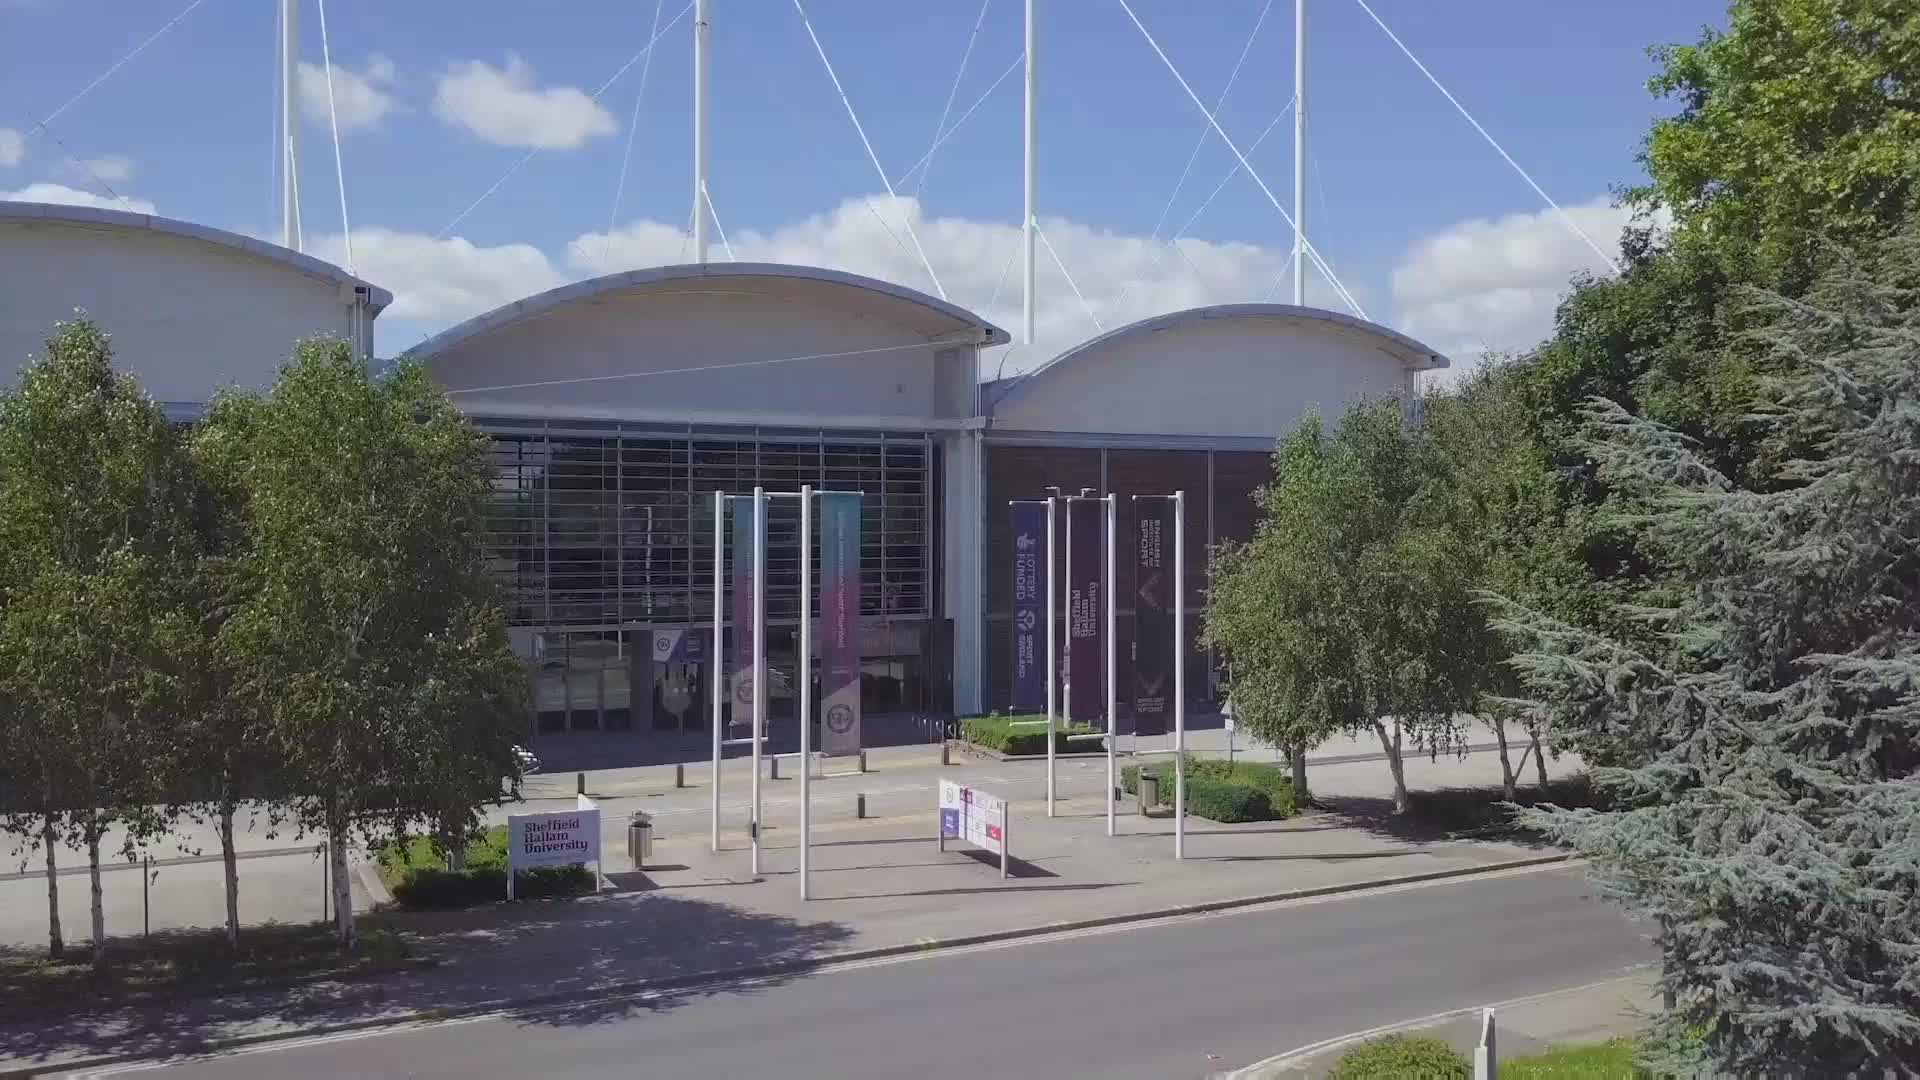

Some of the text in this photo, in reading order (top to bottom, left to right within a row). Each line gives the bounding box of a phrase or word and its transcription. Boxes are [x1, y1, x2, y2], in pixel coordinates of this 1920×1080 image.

[1140, 519, 1149, 568] SPORT
[1016, 553, 1026, 601] FUNDED
[1027, 553, 1036, 599] LOTTERY
[1072, 589, 1081, 638] Sheffield
[1081, 598, 1089, 638] Hallam
[1088, 581, 1098, 638] University
[524, 817, 580, 833] Sheffield
[524, 831, 569, 843] Hallam
[524, 839, 588, 854] University
